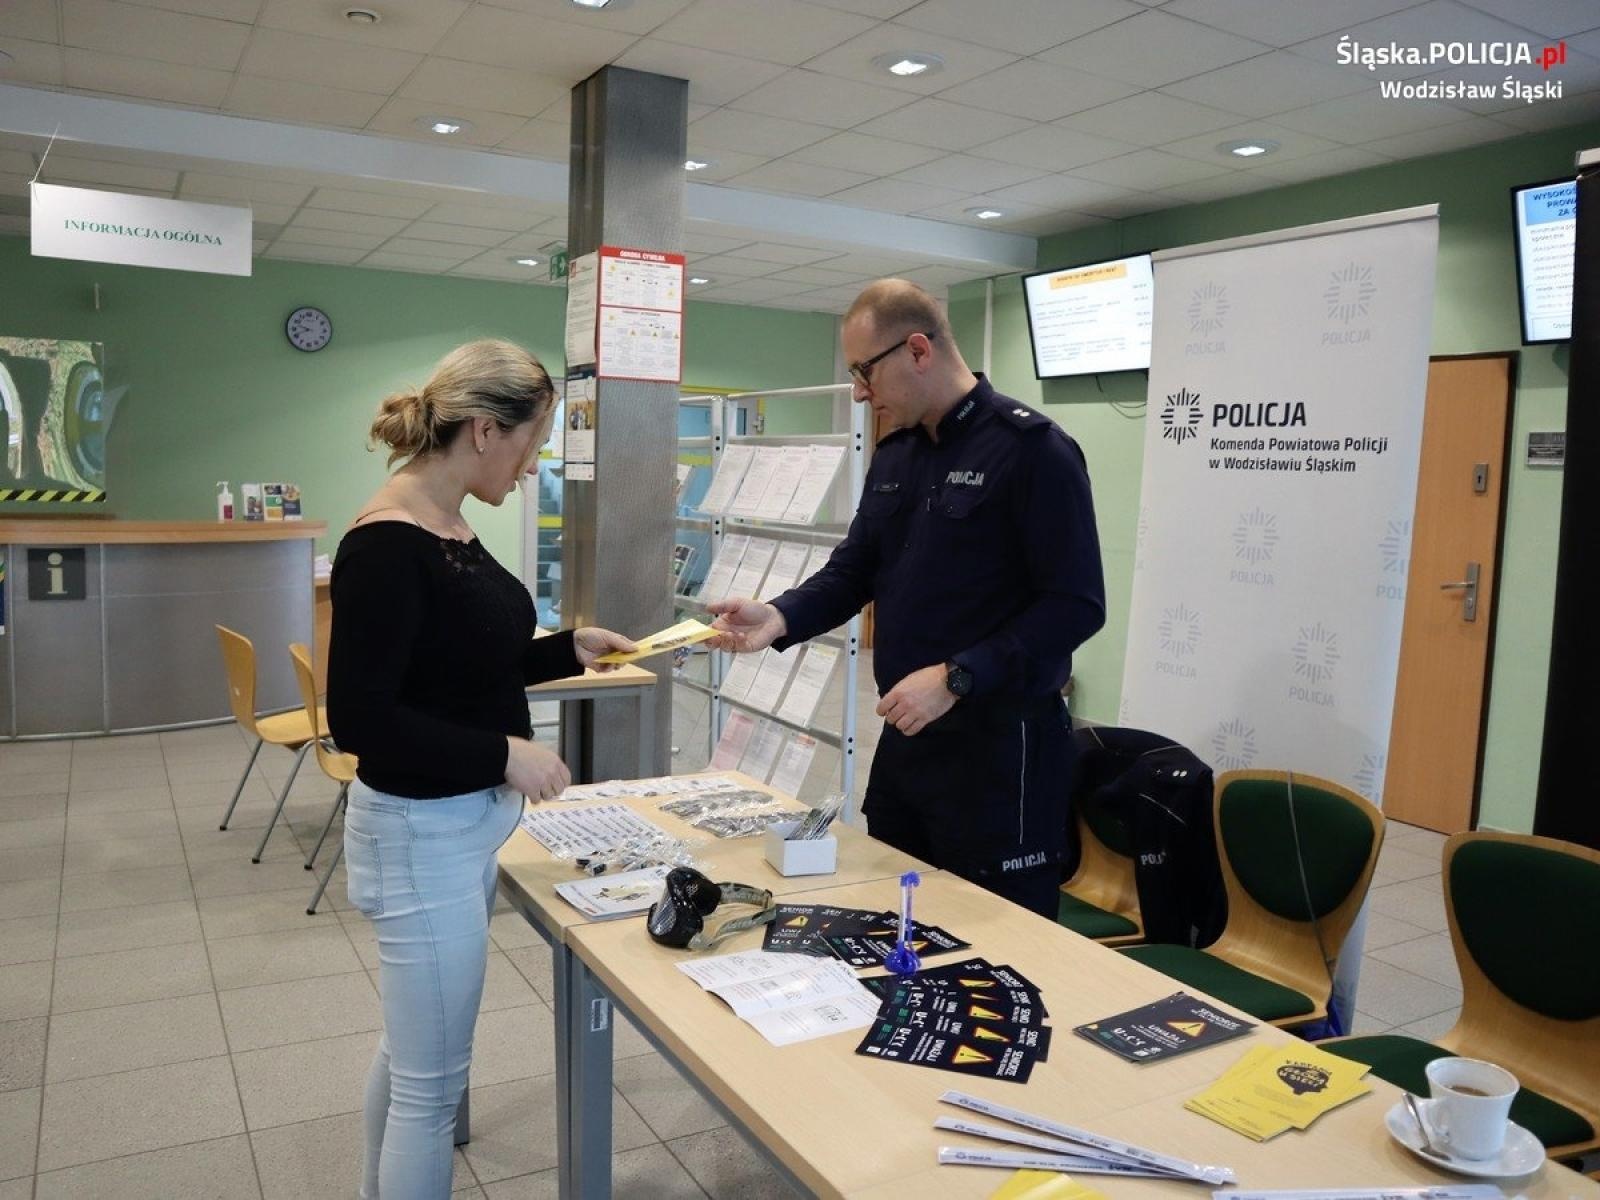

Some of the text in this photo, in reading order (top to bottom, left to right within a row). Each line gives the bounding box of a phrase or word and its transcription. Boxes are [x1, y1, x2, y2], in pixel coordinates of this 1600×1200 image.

[64, 219, 223, 246] INFORMACJA OGÓLNA
[1322, 329, 1372, 346] POLICJA
[1185, 342, 1227, 356] POLICJA
[1212, 402, 1307, 427] POLICJA
[1210, 436, 1388, 454] Komenda Powiatowa Policji
[1208, 455, 1356, 475] w Wodzisławiu Śląskim
[946, 470, 985, 486] POLICJA
[1230, 570, 1274, 586] POLICJA
[1155, 661, 1197, 680] POLICJA
[1289, 686, 1335, 707] POLICJA
[1002, 851, 1047, 872] POLICJA
